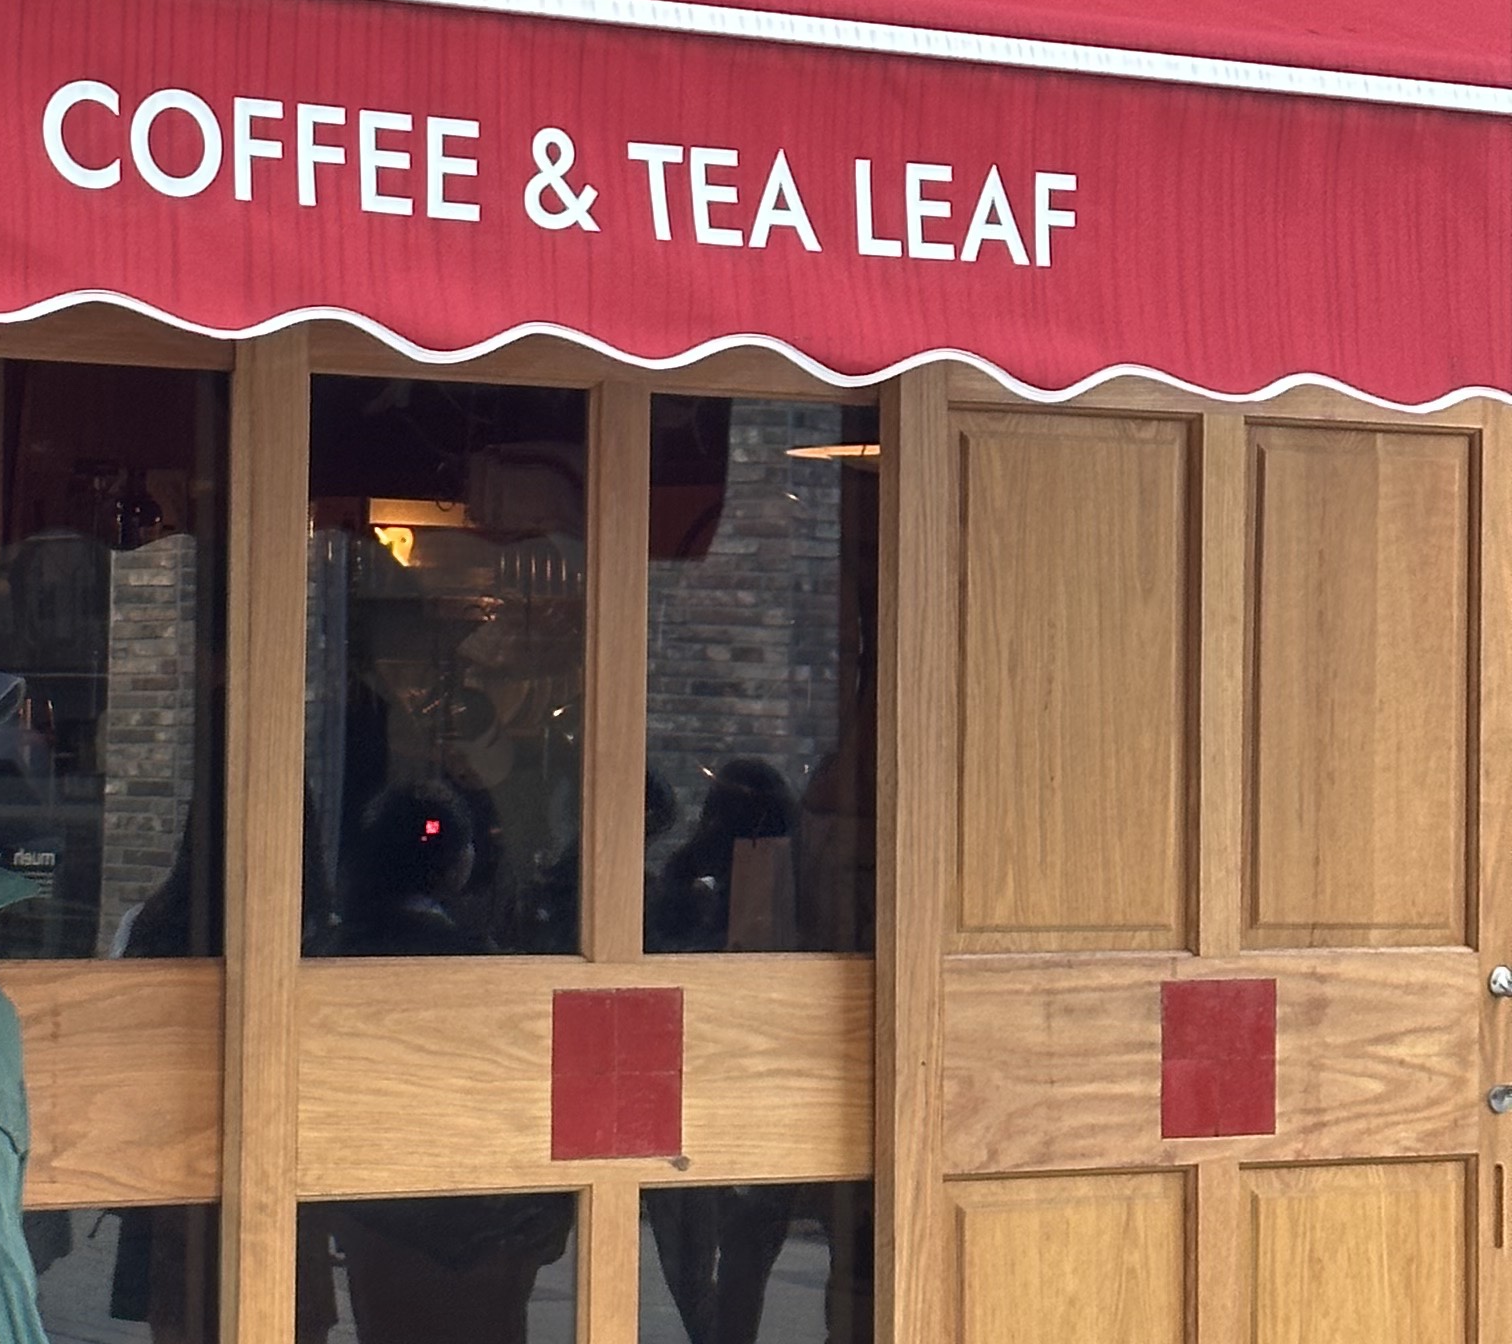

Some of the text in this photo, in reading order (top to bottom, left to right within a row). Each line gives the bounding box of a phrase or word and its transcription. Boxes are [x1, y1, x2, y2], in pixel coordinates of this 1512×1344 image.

[42, 80, 1078, 268] COFFEE & TEA LEAF
